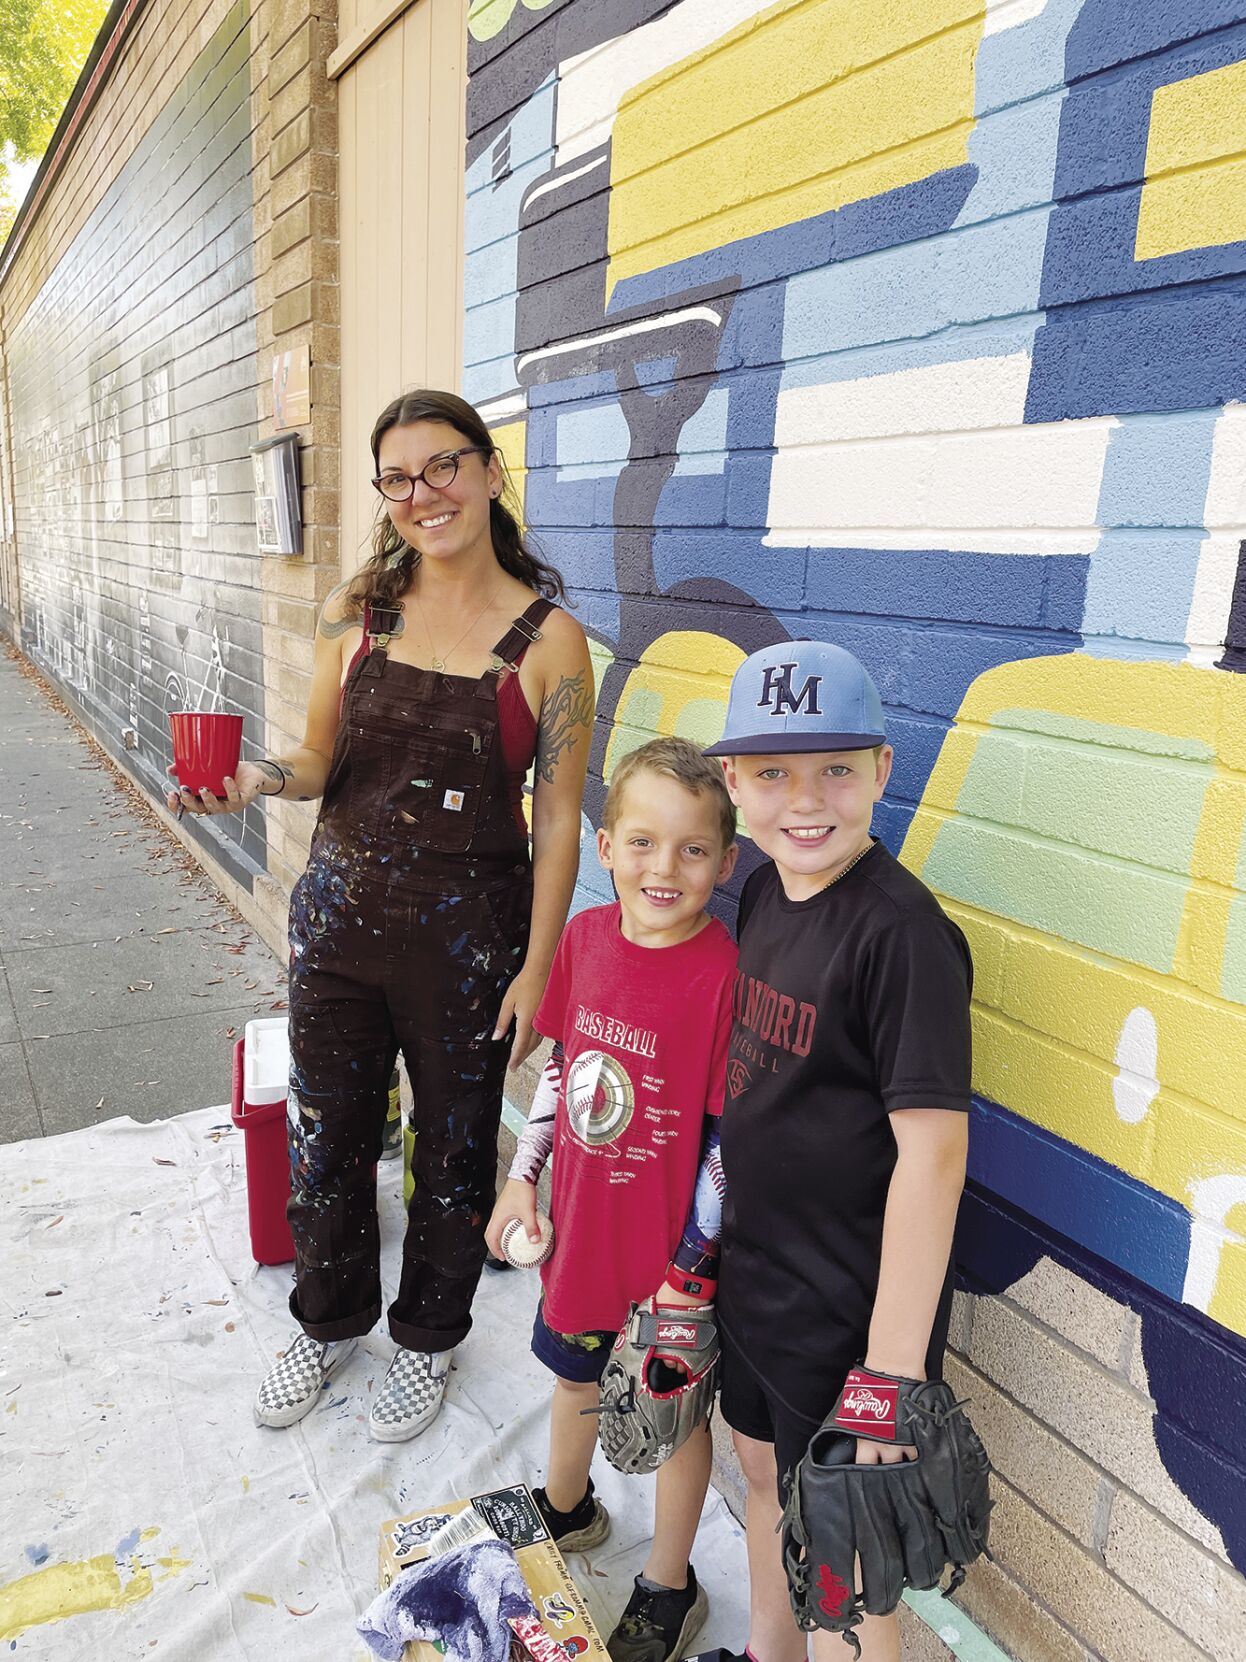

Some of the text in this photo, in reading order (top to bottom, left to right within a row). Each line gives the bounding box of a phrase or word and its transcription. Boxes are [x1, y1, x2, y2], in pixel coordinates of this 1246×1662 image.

[574, 1004, 658, 1059] BASEBALL
[658, 1327, 696, 1340] Rawlings
[843, 1391, 891, 1419] Rawlings
